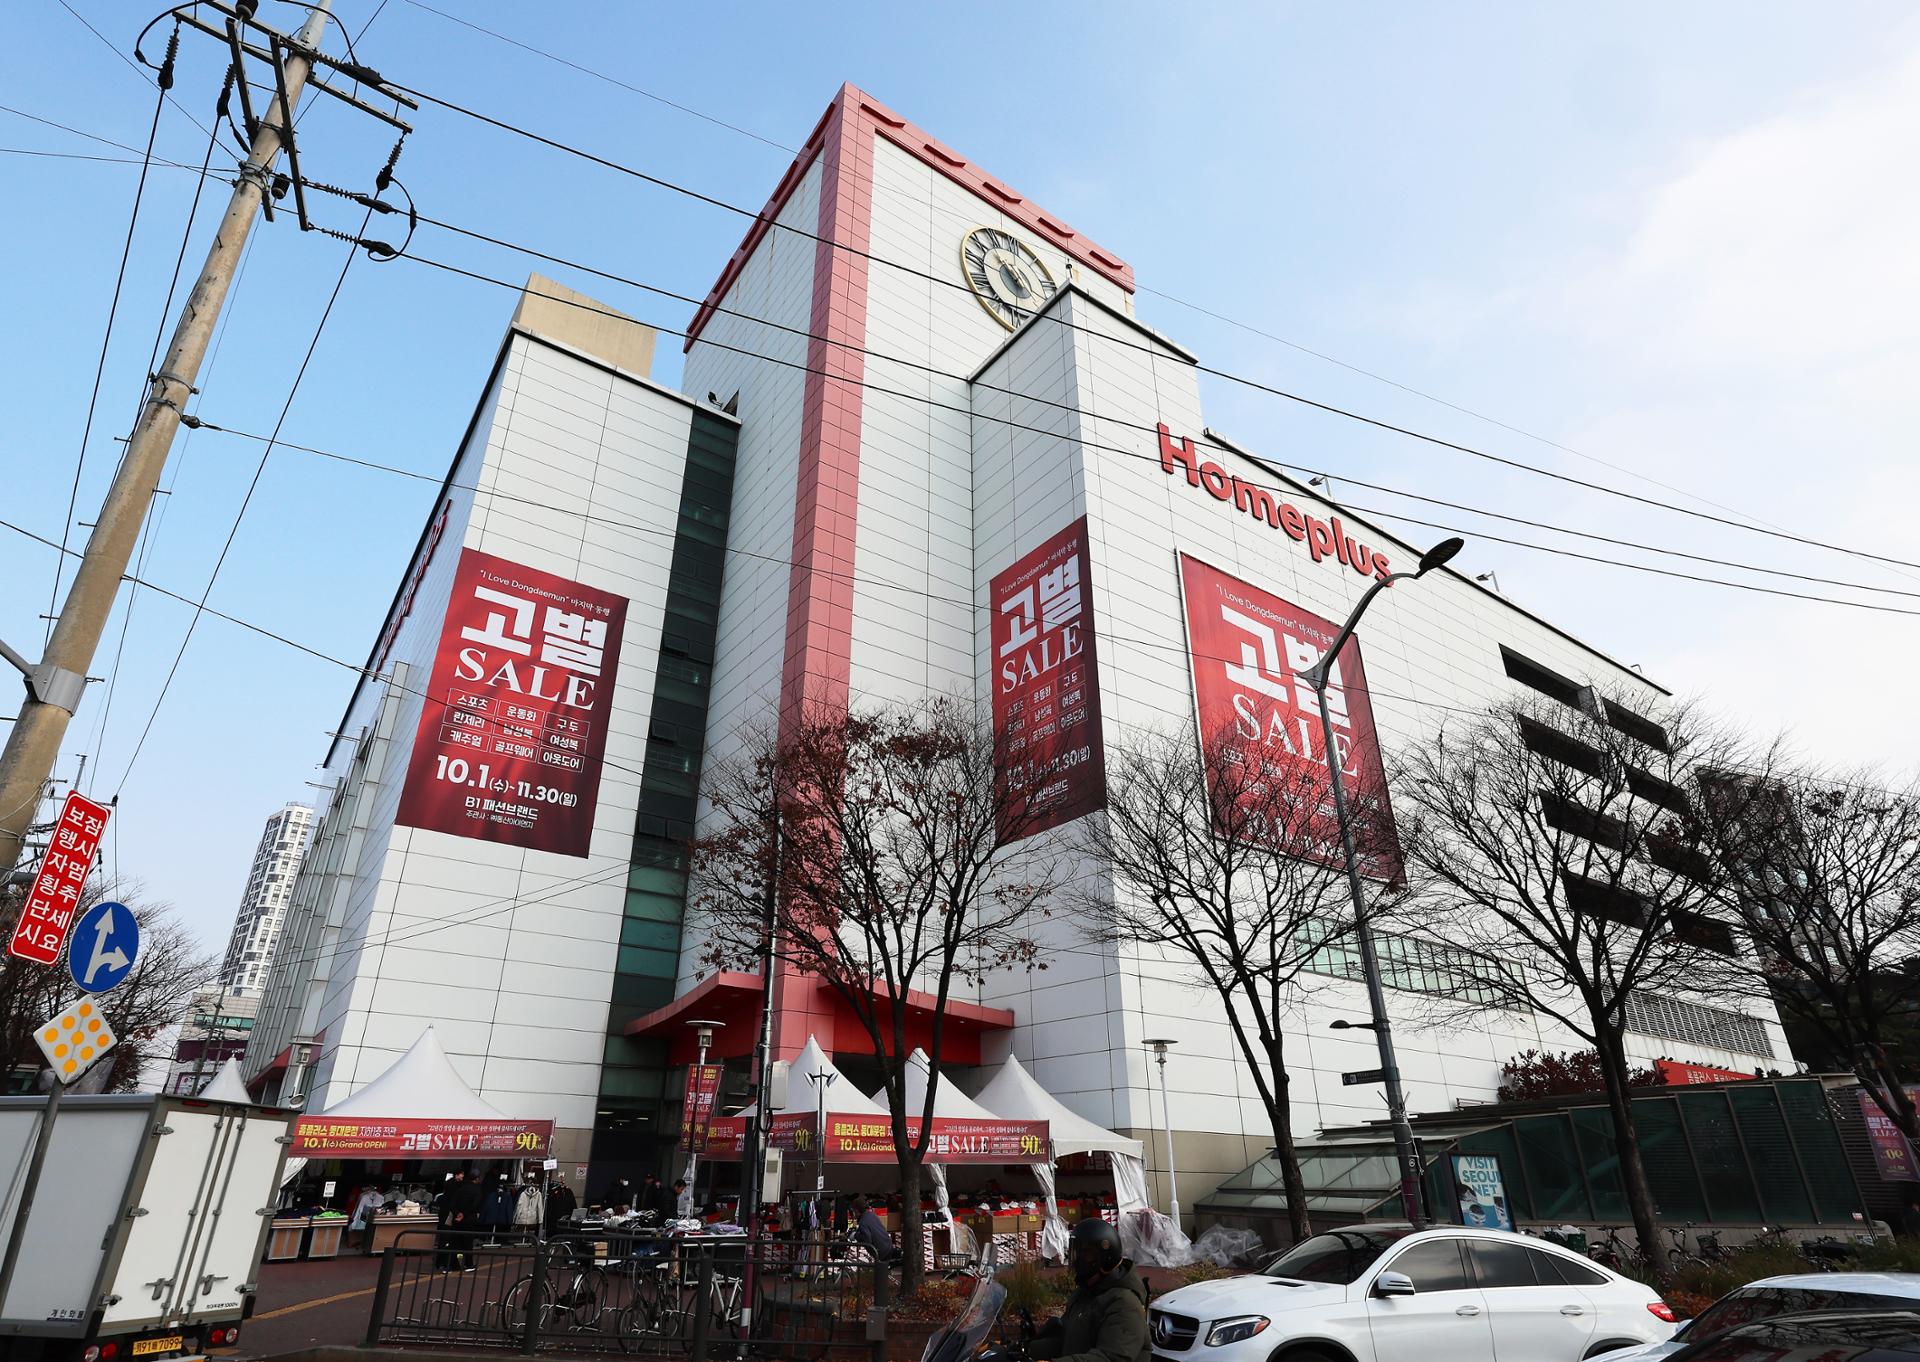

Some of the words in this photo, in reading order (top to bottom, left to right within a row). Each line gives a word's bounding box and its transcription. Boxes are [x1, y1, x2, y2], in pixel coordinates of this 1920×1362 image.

[1157, 422, 1394, 587] Homeplus
[488, 574, 509, 585] Love
[1005, 582, 1017, 593] Love
[1000, 554, 1082, 658] 고별
[1224, 588, 1244, 606] Love
[460, 585, 608, 676] 고별
[1002, 621, 1084, 694] SALE
[1221, 604, 1351, 728] 고별
[454, 648, 595, 710] SALE
[457, 694, 488, 711] 스포츠
[453, 711, 485, 729] 란제리
[506, 706, 537, 722] 운동화
[450, 730, 483, 747] 캐주얼
[503, 724, 533, 740] 남성복
[1232, 693, 1357, 777] SALE
[495, 740, 533, 759] 골프웨어
[550, 735, 579, 750] 여성복
[543, 752, 580, 769] 아웃도어
[465, 796, 480, 808] B1
[482, 798, 539, 820] 패션브랜드
[298, 1124, 328, 1136] 홈플러스
[329, 1125, 359, 1137] 동대문점
[834, 1123, 860, 1136] 홈플러스
[861, 1124, 886, 1137] 동대문점
[400, 1133, 431, 1151] 고별
[432, 1133, 479, 1150] SALE
[871, 1142, 892, 1151] Grand
[951, 1135, 989, 1154] SALE
[1465, 1156, 1494, 1168] VISIT
